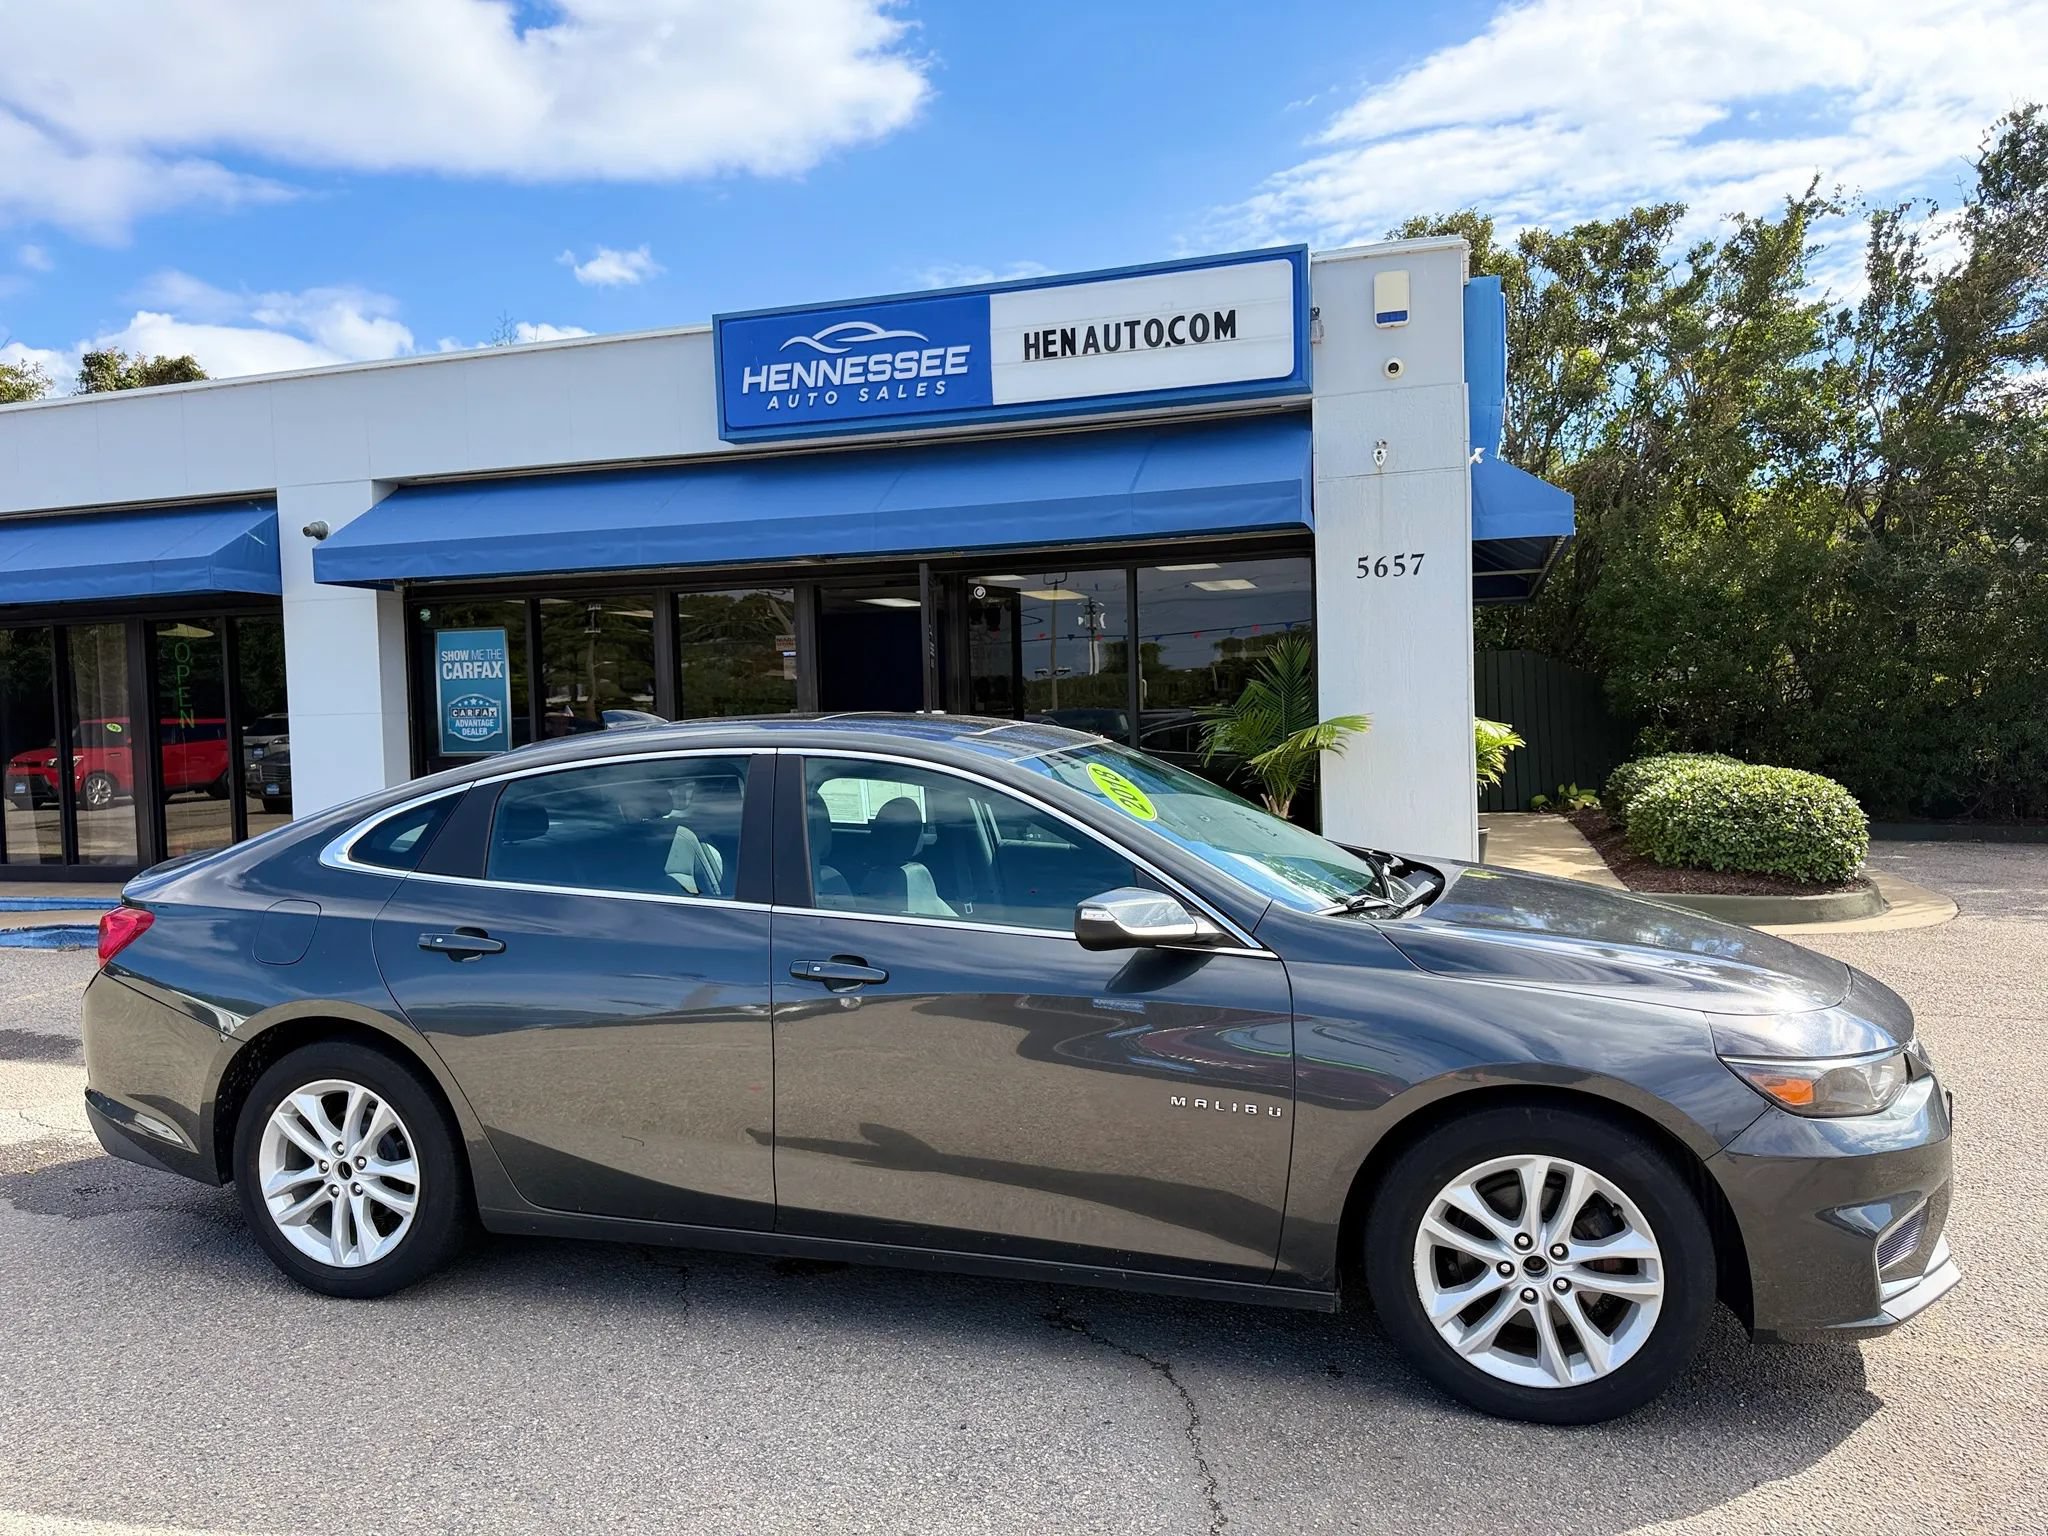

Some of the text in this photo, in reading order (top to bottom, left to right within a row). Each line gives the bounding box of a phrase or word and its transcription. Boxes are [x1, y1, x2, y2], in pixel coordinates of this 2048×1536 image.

[1024, 309, 1236, 361] HENAUTO.COM
[742, 345, 971, 393] HENNESSEE
[767, 380, 946, 410] AUTO SALES
[1356, 553, 1425, 579] 5657
[441, 648, 503, 662] SHOW ME THE
[443, 661, 504, 679] CARFAX
[174, 642, 195, 729] OPEN
[452, 707, 497, 718] CARFAX
[455, 719, 495, 728] ADVANTAGE
[462, 727, 488, 736] DEALER
[1091, 767, 1153, 816] 2018
[1170, 1096, 1282, 1118] MALIBU
